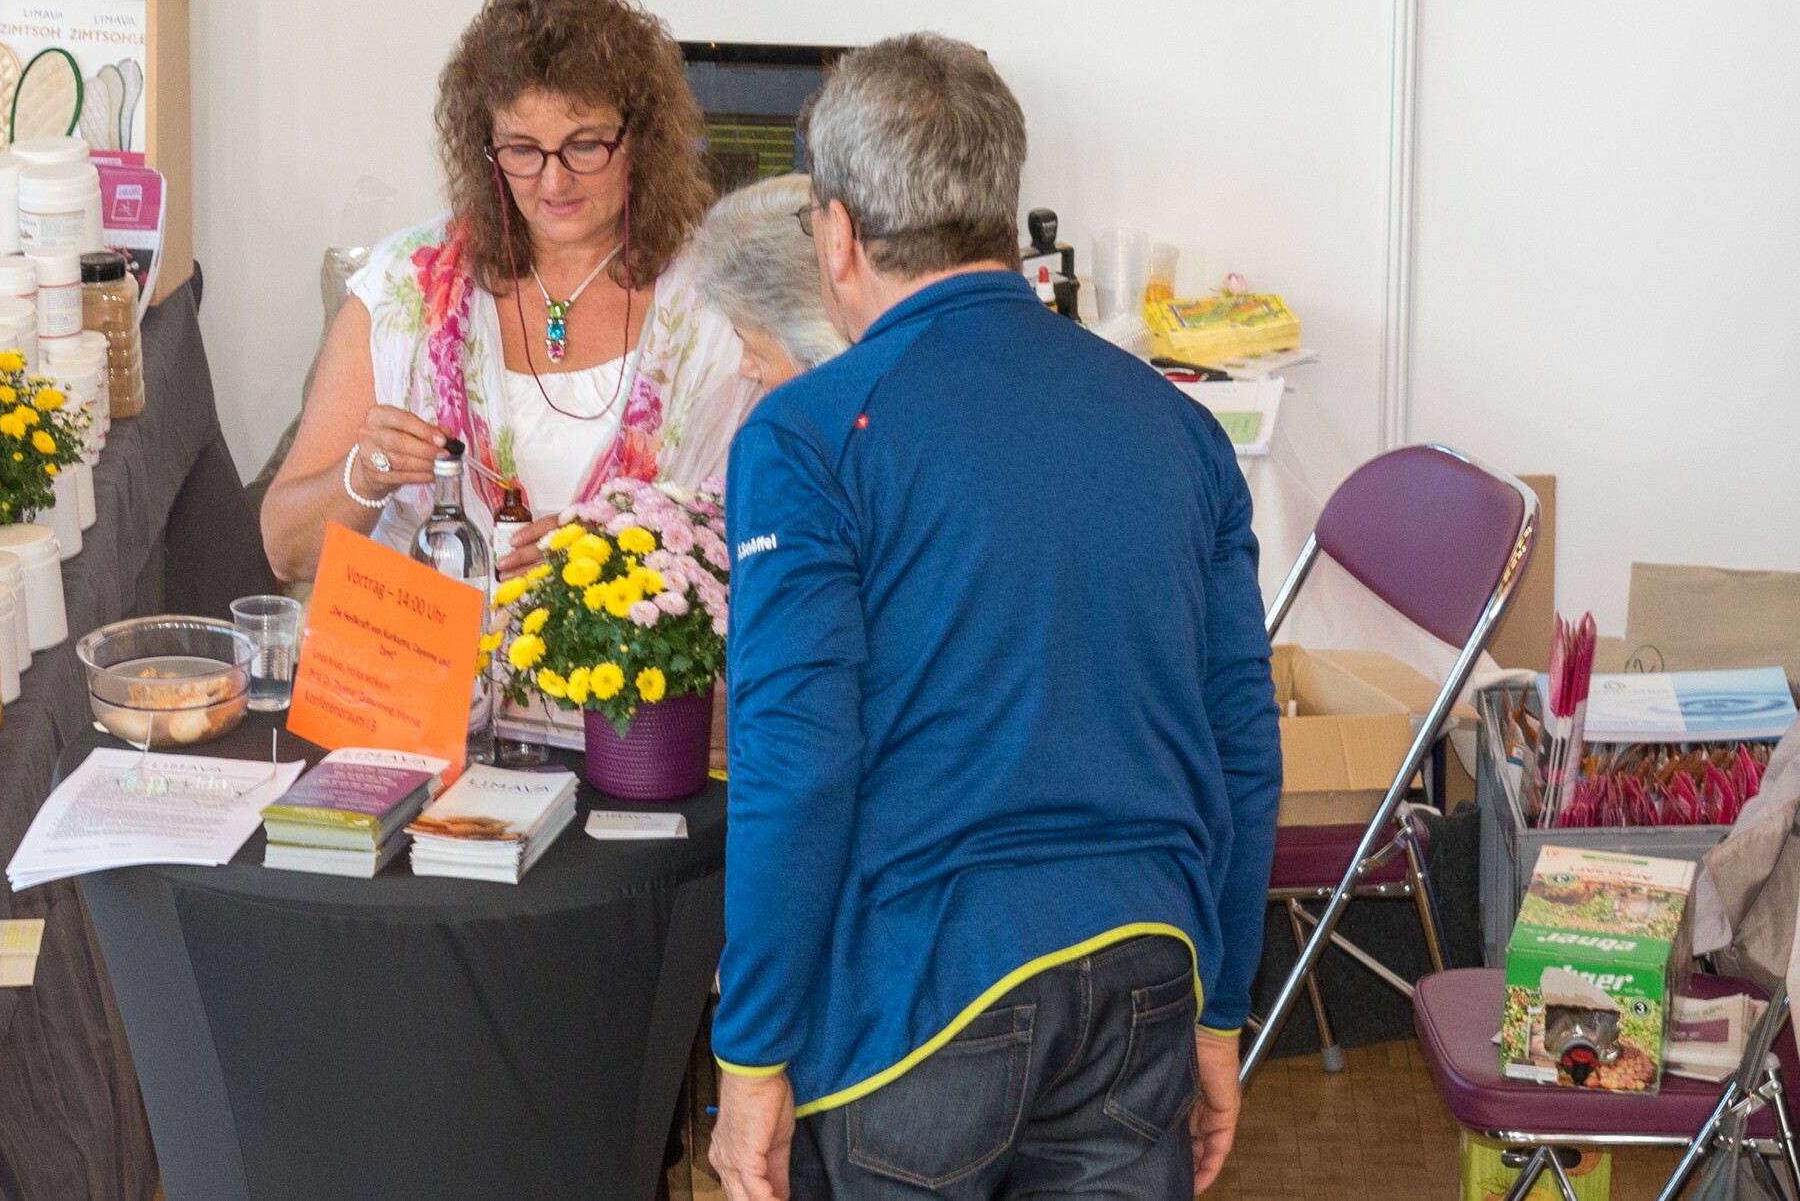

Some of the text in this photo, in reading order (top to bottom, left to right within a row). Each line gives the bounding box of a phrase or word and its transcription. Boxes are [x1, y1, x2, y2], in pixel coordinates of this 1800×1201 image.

[93, 14, 136, 26] LIMAVA
[0, 23, 61, 39] ZIMTSOH
[347, 563, 385, 601] Vortrag
[397, 587, 426, 616] 14:00
[427, 602, 448, 626] Uhr
[342, 750, 427, 767] LIMAVA
[151, 762, 221, 773] LIMAVA
[467, 778, 550, 793] LIMAVA
